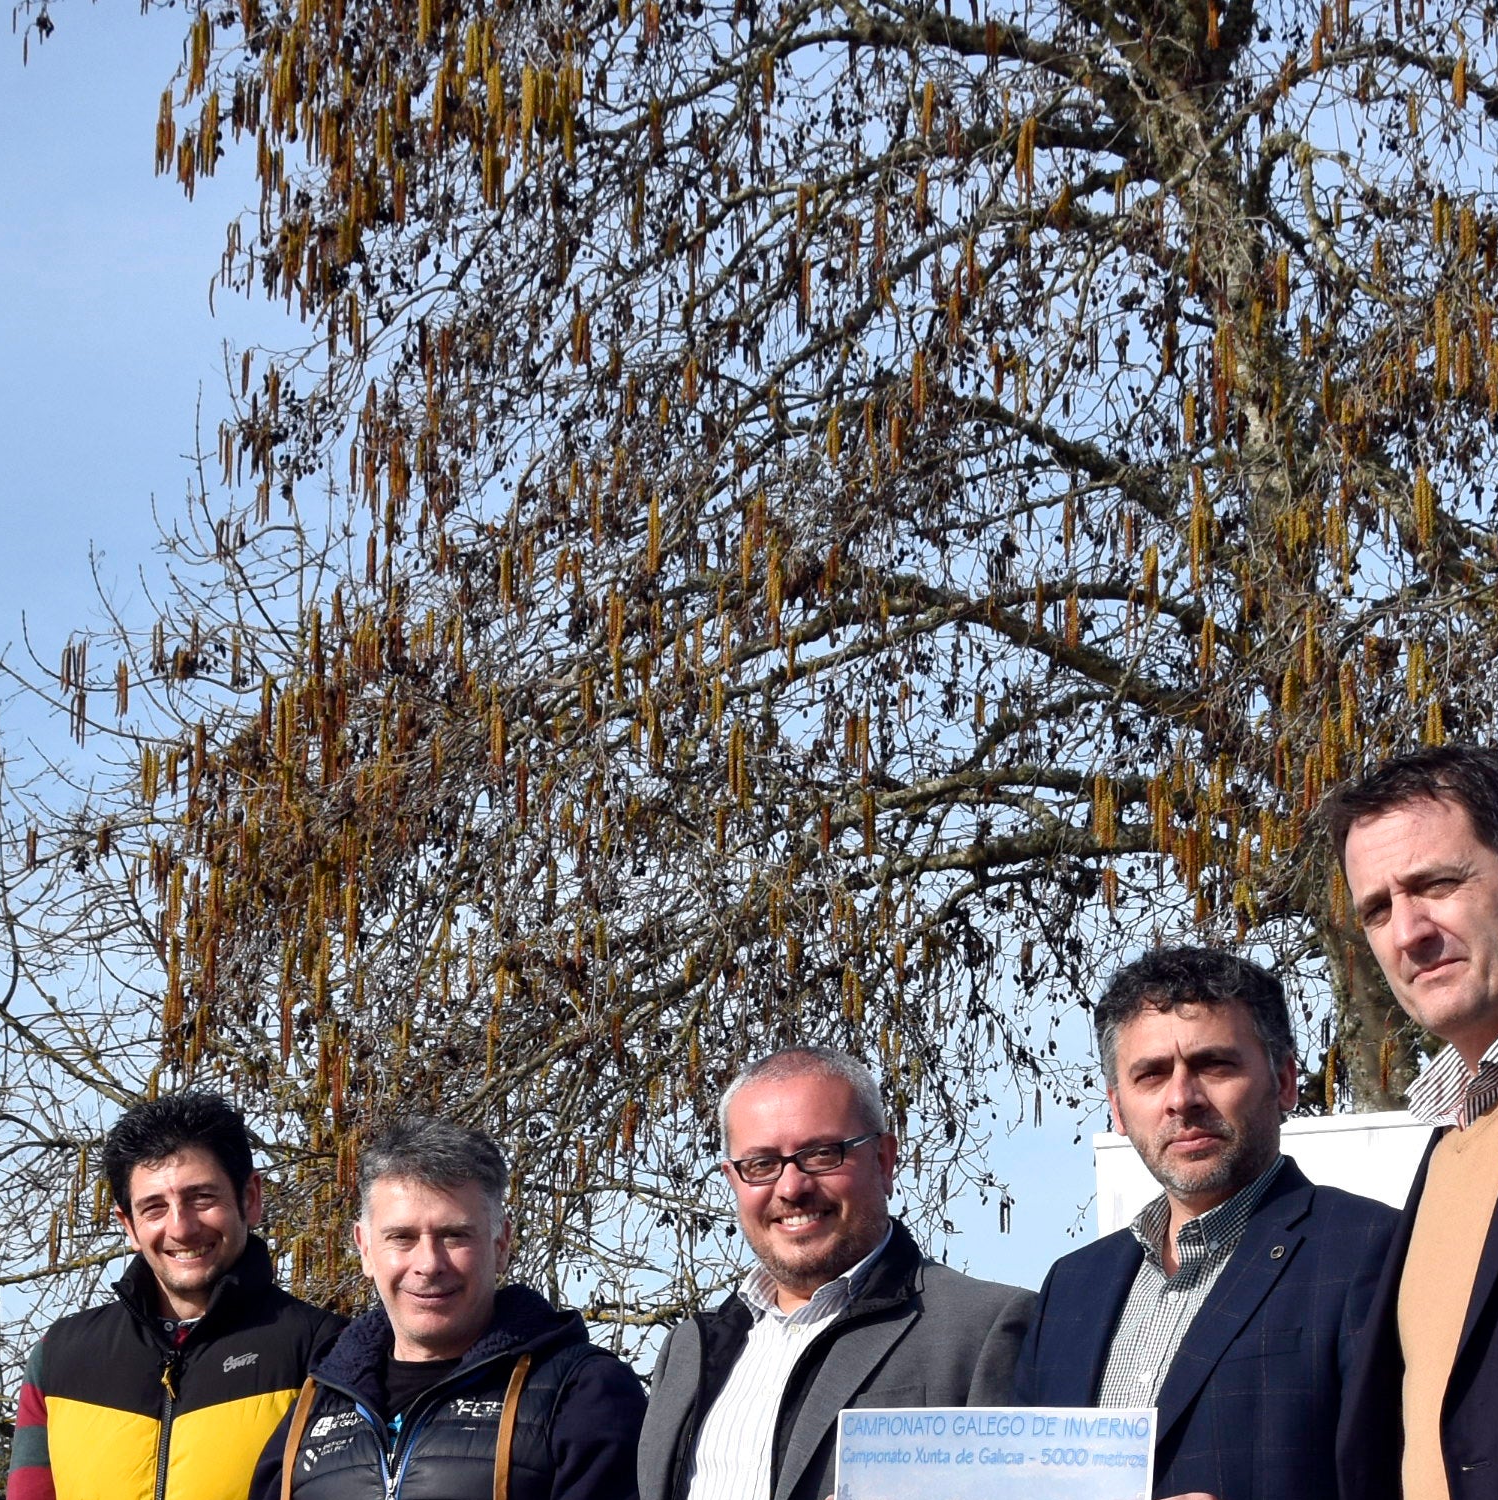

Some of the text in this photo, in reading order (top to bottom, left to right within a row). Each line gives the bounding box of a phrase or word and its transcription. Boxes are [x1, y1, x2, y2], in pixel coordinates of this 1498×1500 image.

[844, 1416, 1149, 1439] CAMPIONATO GALEGO DE INVERNO
[841, 1448, 911, 1469] Campionato
[914, 1447, 951, 1465] Xunta
[955, 1447, 974, 1464] de
[978, 1447, 1025, 1465] Galicia
[1039, 1447, 1089, 1467] 5000
[1092, 1448, 1148, 1469] metros
